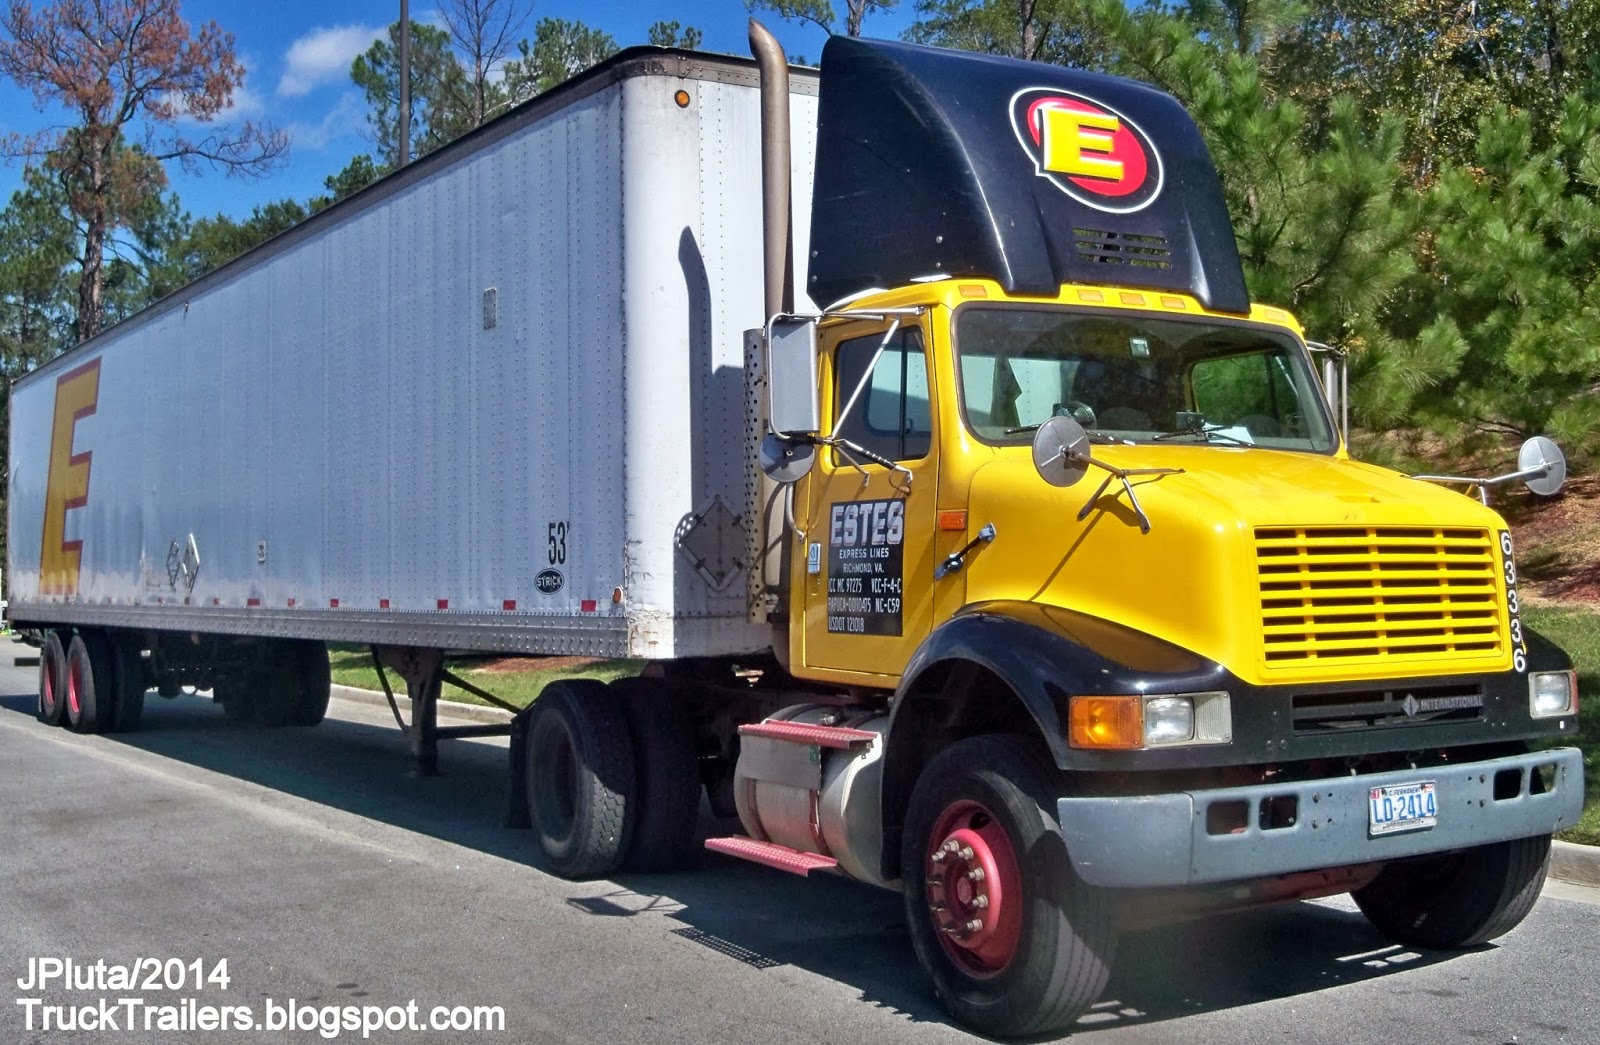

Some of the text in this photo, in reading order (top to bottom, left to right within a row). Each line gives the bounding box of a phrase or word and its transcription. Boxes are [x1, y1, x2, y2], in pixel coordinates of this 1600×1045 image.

[1041, 107, 1124, 182] E
[831, 501, 904, 546] ESTES
[839, 548, 889, 558] EXPRESS LINES
[843, 563, 885, 574] RICHMOND, VA.
[536, 577, 562, 588] STRICK
[846, 578, 863, 592] 97275
[875, 598, 900, 613] NC-C59
[1501, 532, 1526, 672] 63336
[828, 616, 845, 631] USDOT
[1421, 694, 1483, 711] INTERNATIONAL
